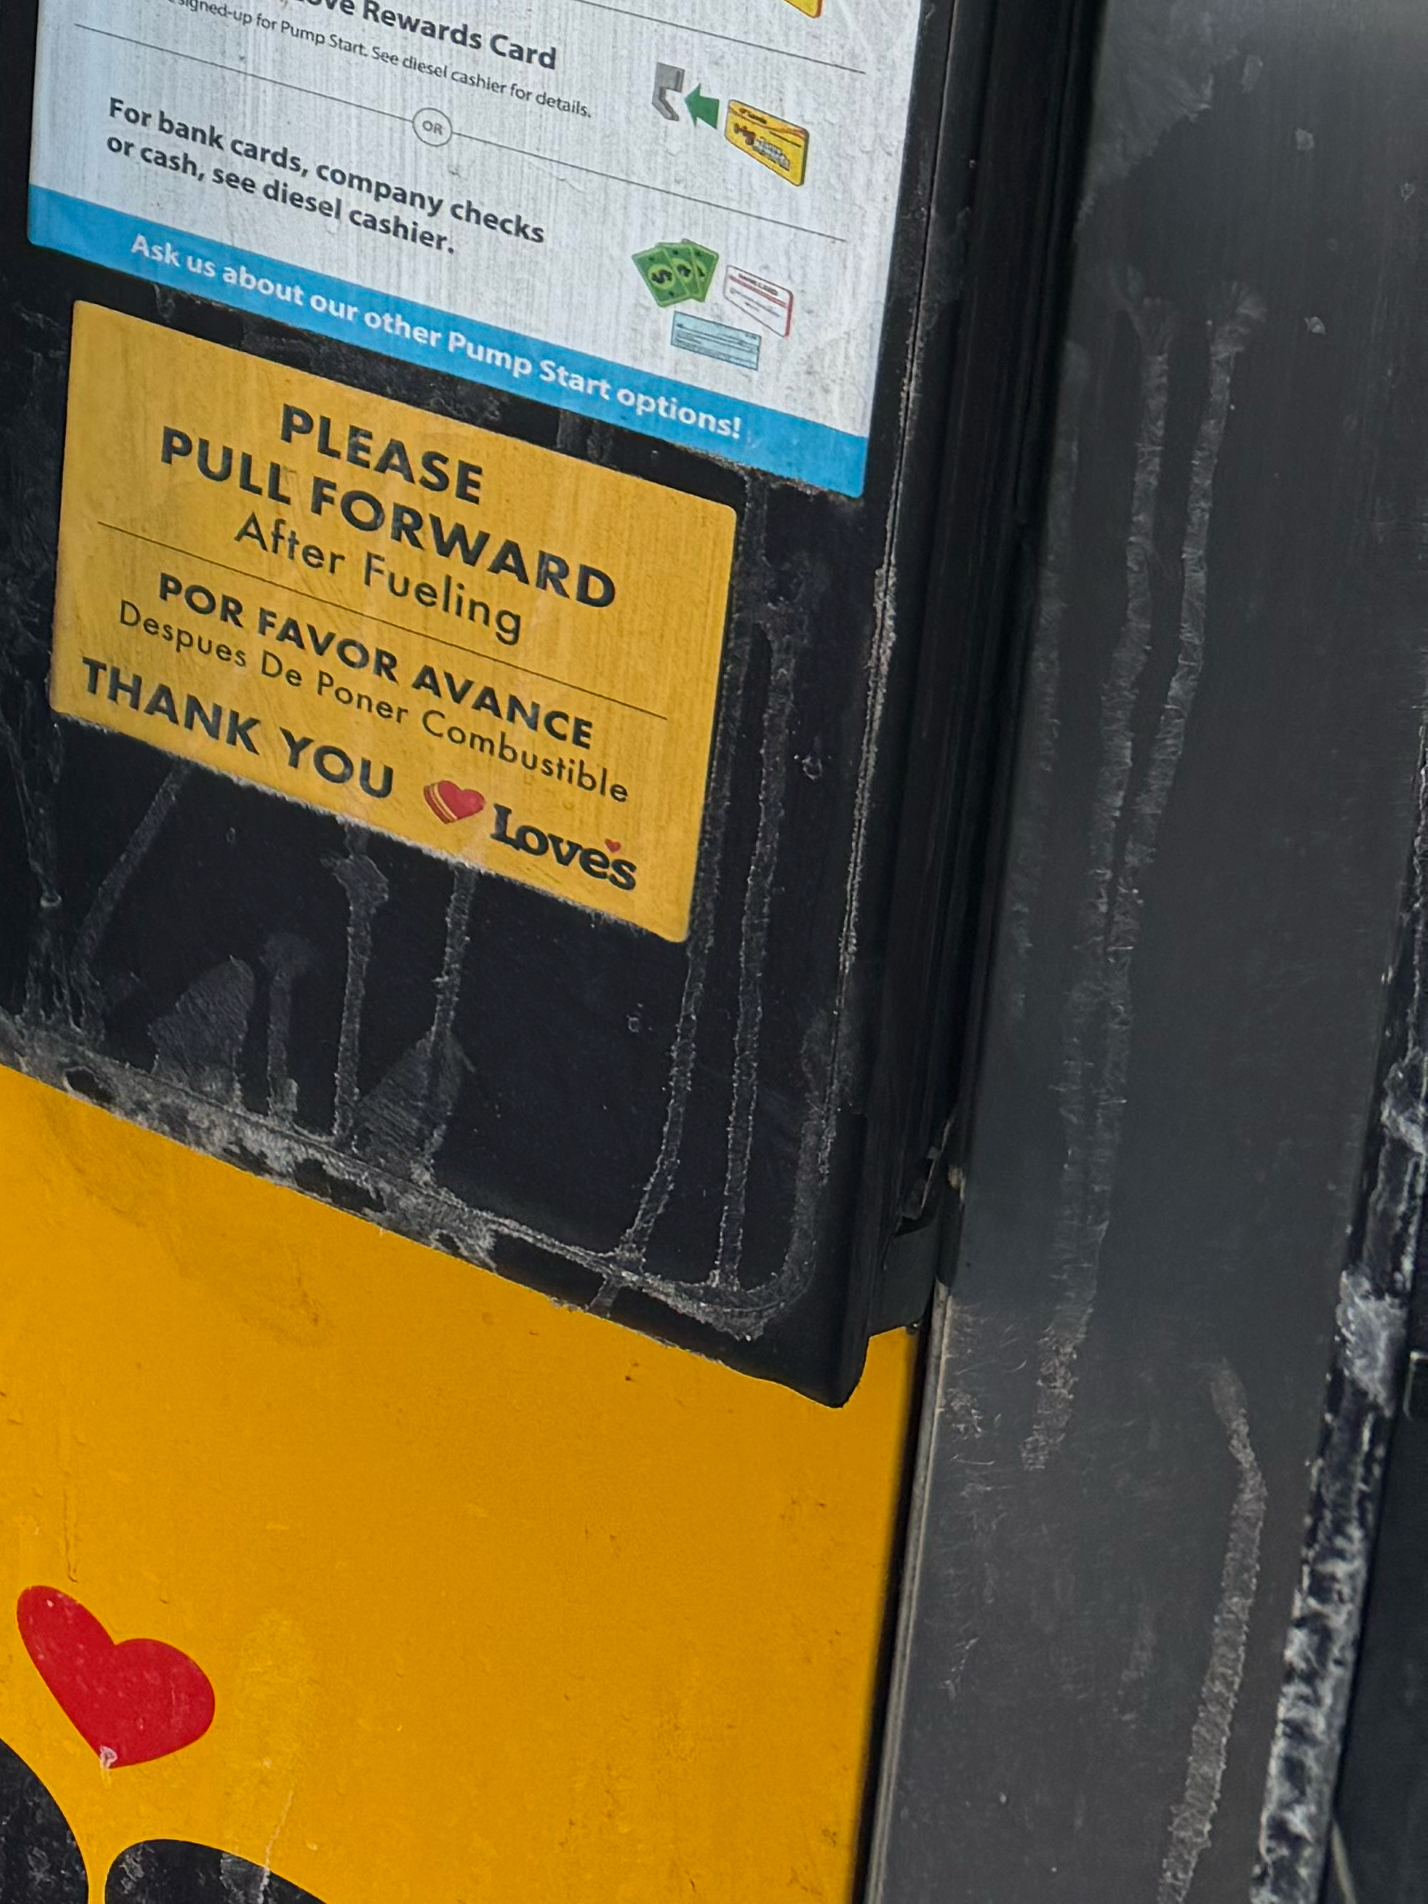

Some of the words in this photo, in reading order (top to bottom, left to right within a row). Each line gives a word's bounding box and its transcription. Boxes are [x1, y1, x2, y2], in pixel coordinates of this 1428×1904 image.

[160, 426, 292, 505] PULL
[310, 476, 616, 610] FORWARD
[279, 402, 485, 506] PLEASE
[233, 513, 345, 577] After
[362, 553, 522, 646] Fueling
[81, 656, 262, 757] THANK
[278, 726, 394, 801] YOU
[119, 600, 247, 668] Despues
[261, 649, 303, 689] De
[316, 673, 409, 726] Poner
[421, 710, 629, 804] Combustible
[158, 572, 244, 628] POR
[258, 608, 399, 682] FAVOR
[411, 664, 594, 749] AVANCE
